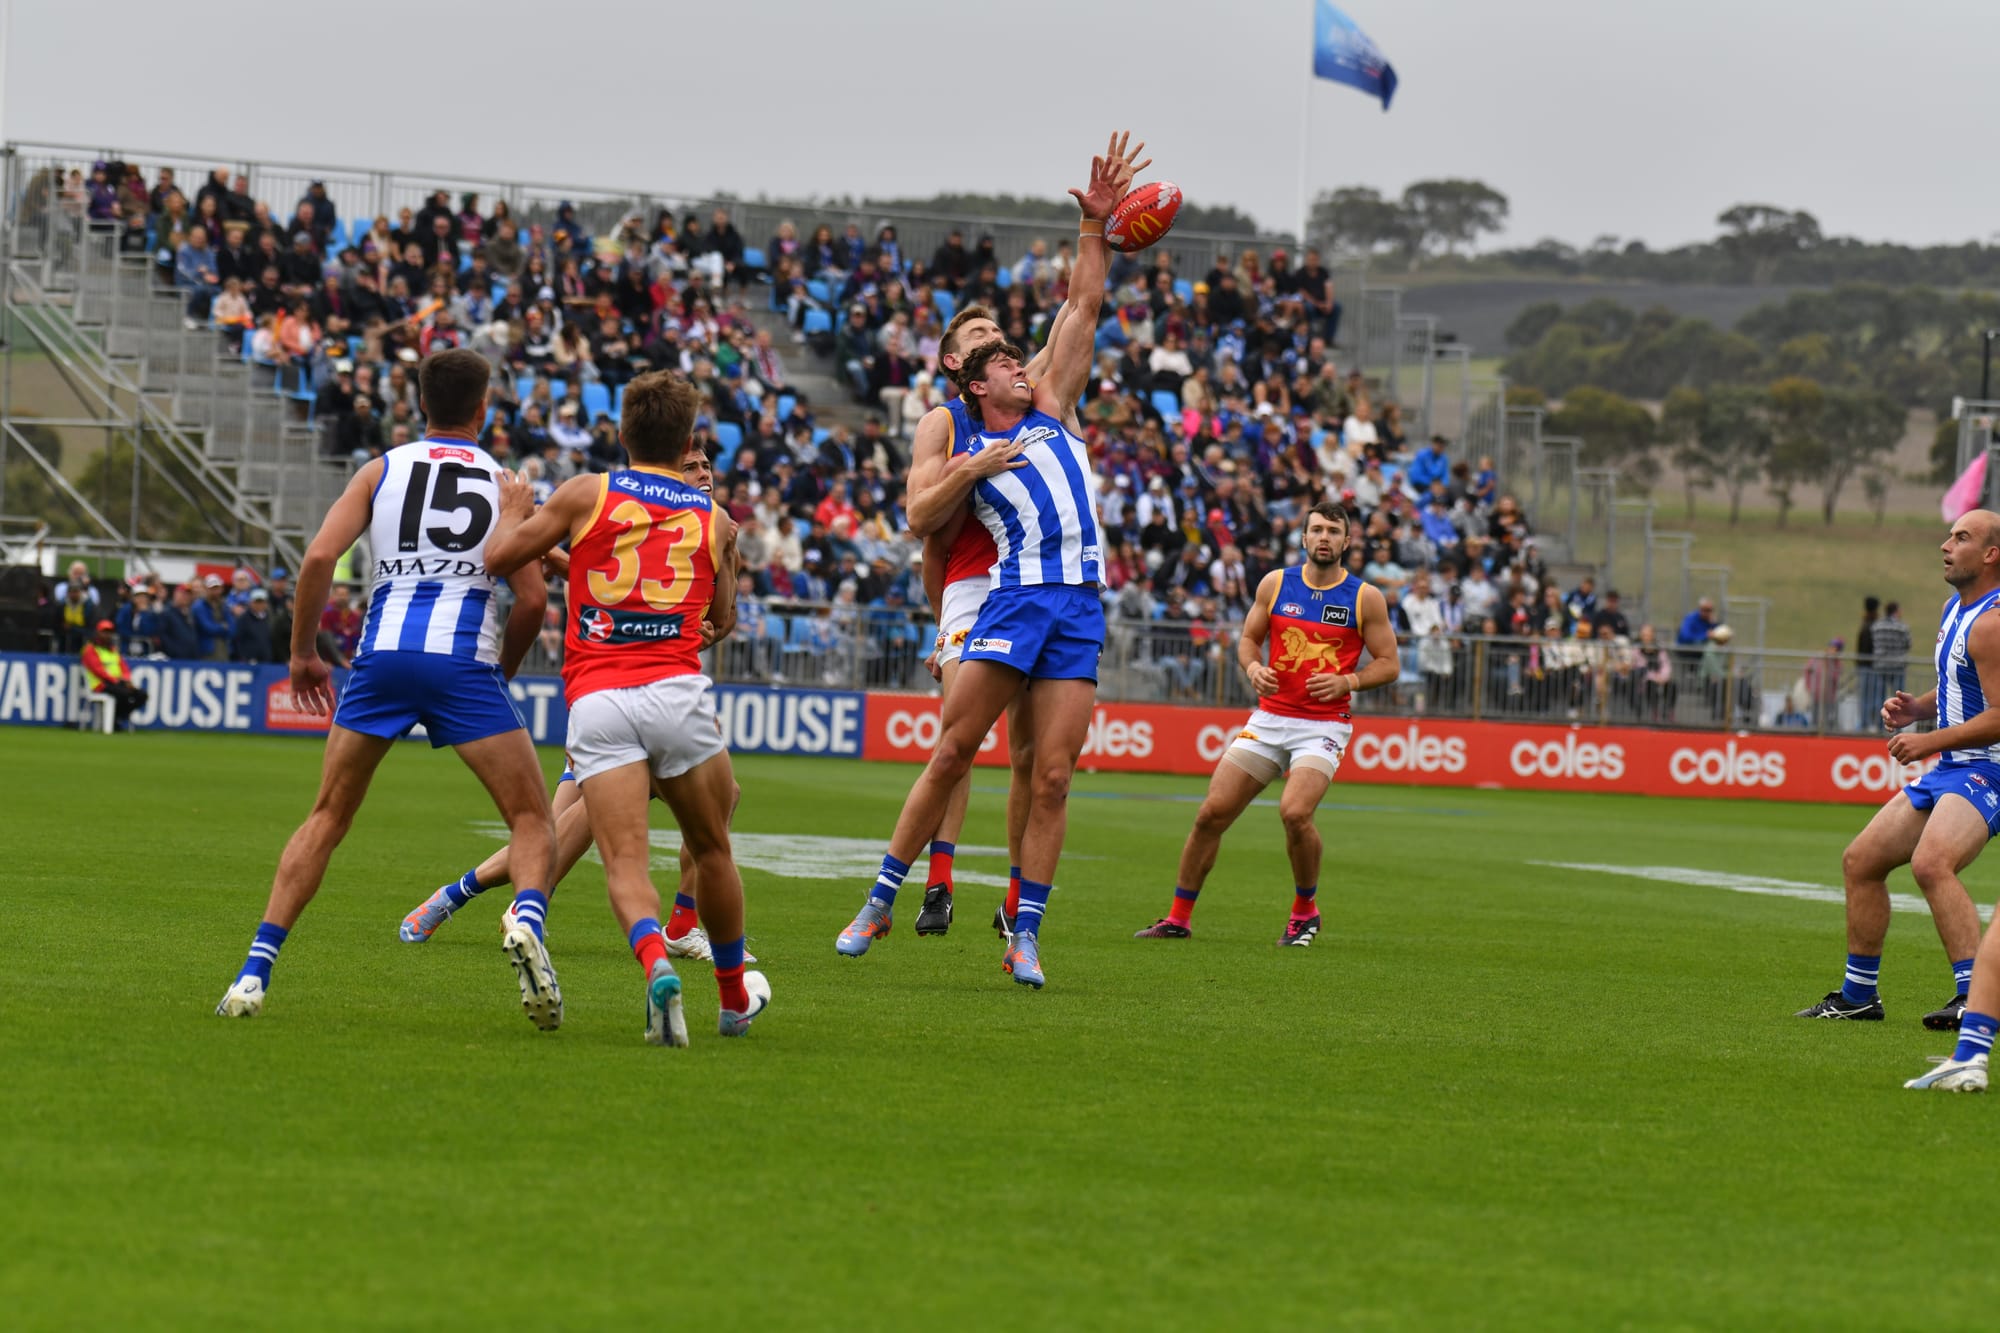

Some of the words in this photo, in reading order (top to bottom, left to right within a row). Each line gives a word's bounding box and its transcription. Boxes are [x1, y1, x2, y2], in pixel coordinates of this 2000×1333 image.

[398, 461, 493, 553] 15
[644, 485, 708, 506] HYUNDAI
[587, 500, 703, 611] 33
[1281, 605, 1303, 616] AFL
[1325, 609, 1346, 620] youi
[1353, 724, 1467, 773] coles
[1510, 732, 1625, 780] coles
[1669, 740, 1786, 788] coles
